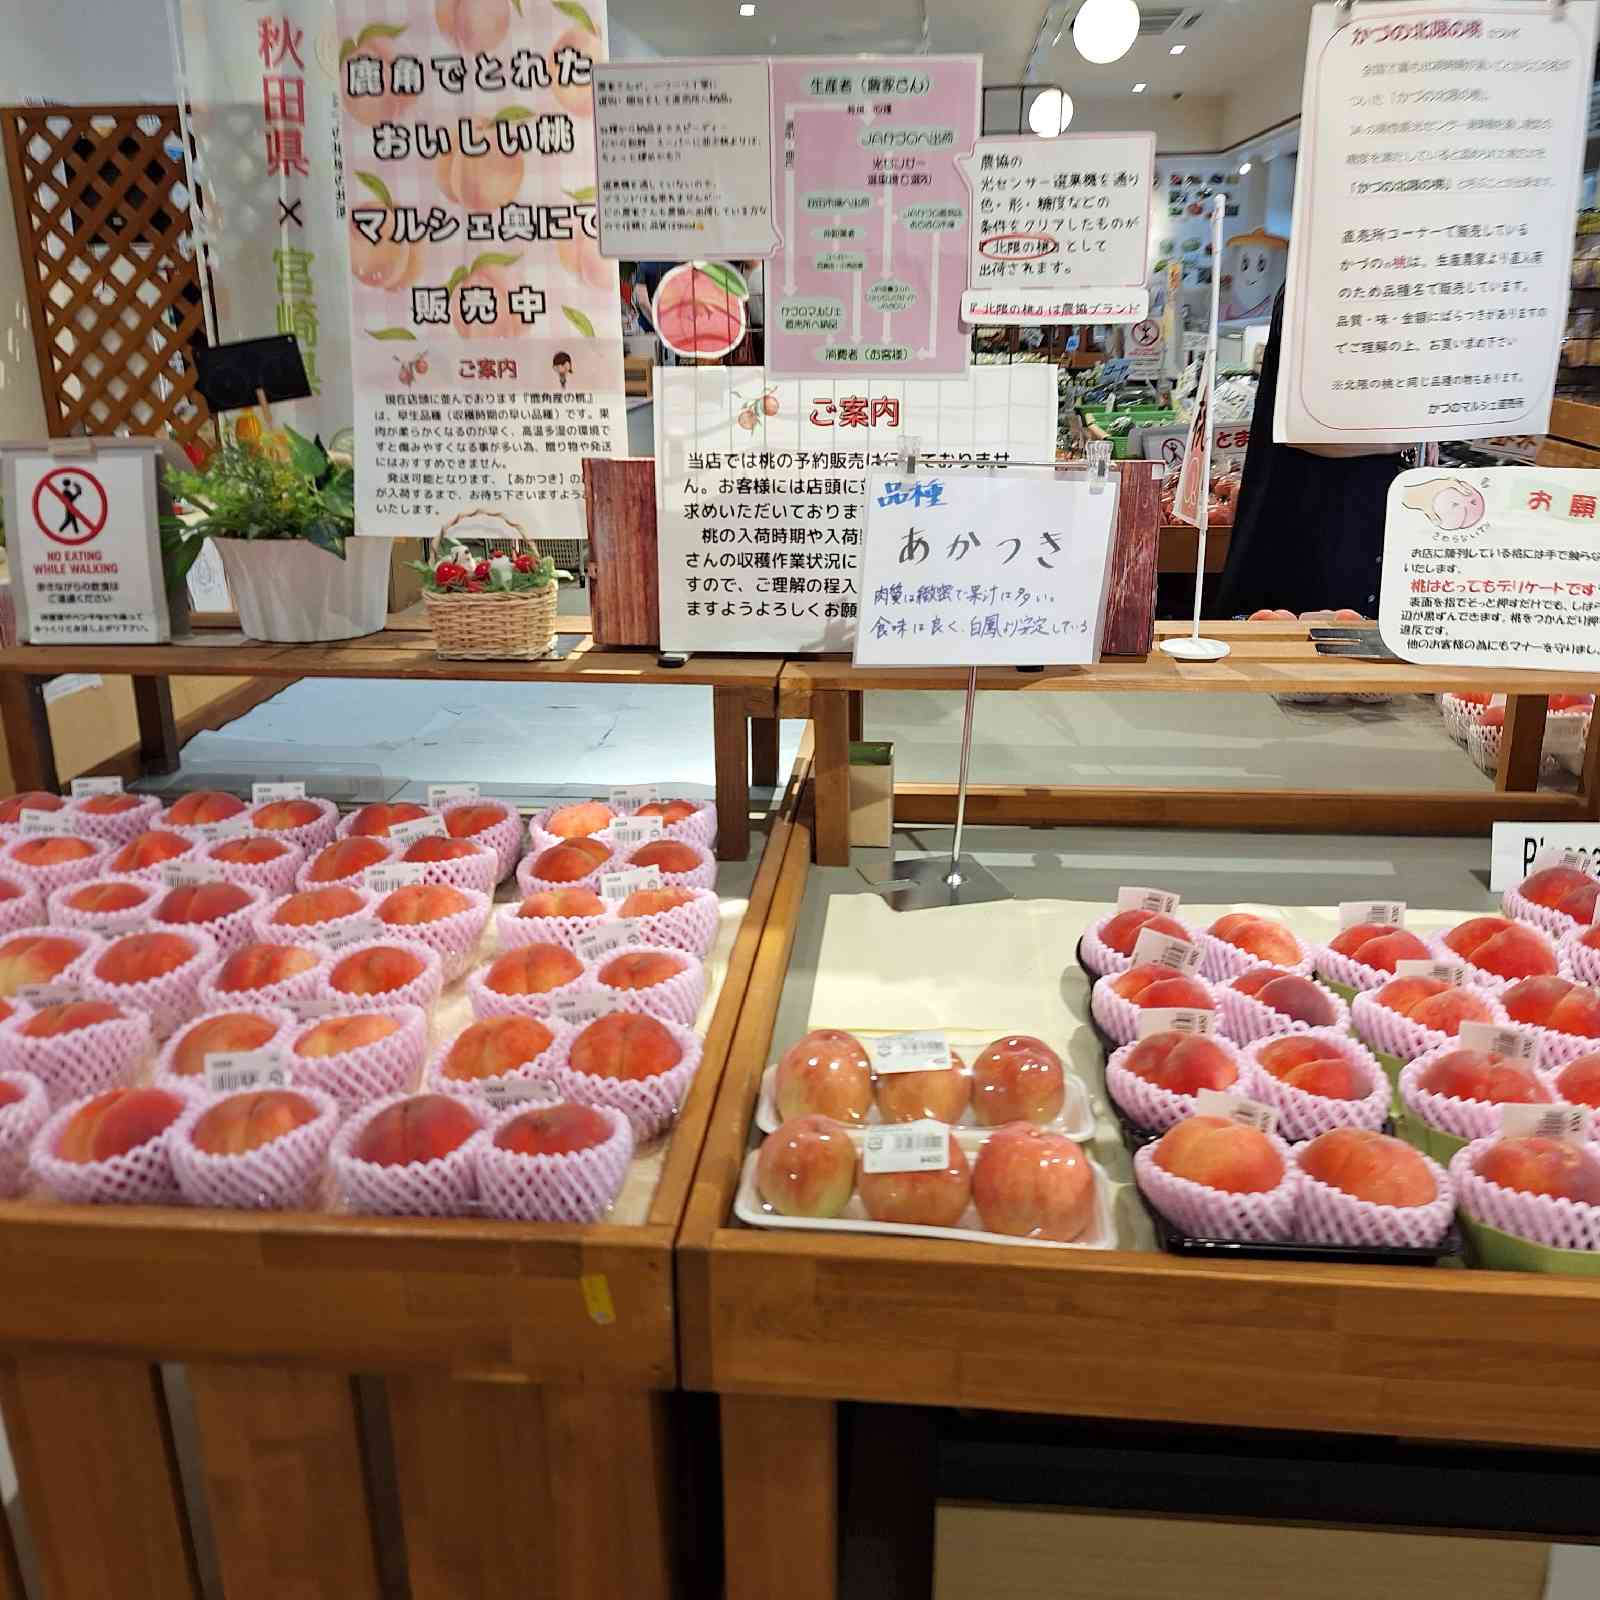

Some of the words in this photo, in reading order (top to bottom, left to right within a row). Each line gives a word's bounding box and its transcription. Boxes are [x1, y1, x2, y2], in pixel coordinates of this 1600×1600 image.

[347, 46, 592, 96] 鹿角でとれた
[373, 115, 574, 160] おいしい桃
[981, 154, 1023, 170] 農協の
[351, 203, 598, 245] マルシェ奥にて
[411, 286, 546, 325] 販売中
[460, 358, 518, 380] ご案内
[808, 395, 901, 427] ご案内
[376, 457, 508, 469] にはおすすめできません。
[687, 451, 1010, 471] 当店では桃の予約販売は行ておりませ
[376, 488, 587, 500] が入荷するまで、お待ち下さいますよう
[877, 479, 950, 509] 品種
[376, 504, 441, 516] いたします。
[684, 503, 864, 520] 求めいただいておりま
[702, 528, 863, 545] 桃の入荷時期や入荷
[47, 552, 62, 561] NO
[64, 551, 102, 561] EATING
[899, 527, 1065, 569] あかつき
[33, 563, 66, 575] WHILE
[71, 562, 119, 574] WALKING
[685, 553, 858, 570] さんの収穫作業状況に
[686, 578, 858, 595] すので、ご理解の程入
[687, 602, 858, 618] ますようよろしくお願
[1401, 611, 1600, 627] 辺が黒ずんできます。桃をつかんだり押
[1407, 639, 1600, 655] 他のお客様の為にもマナーを守りまし
